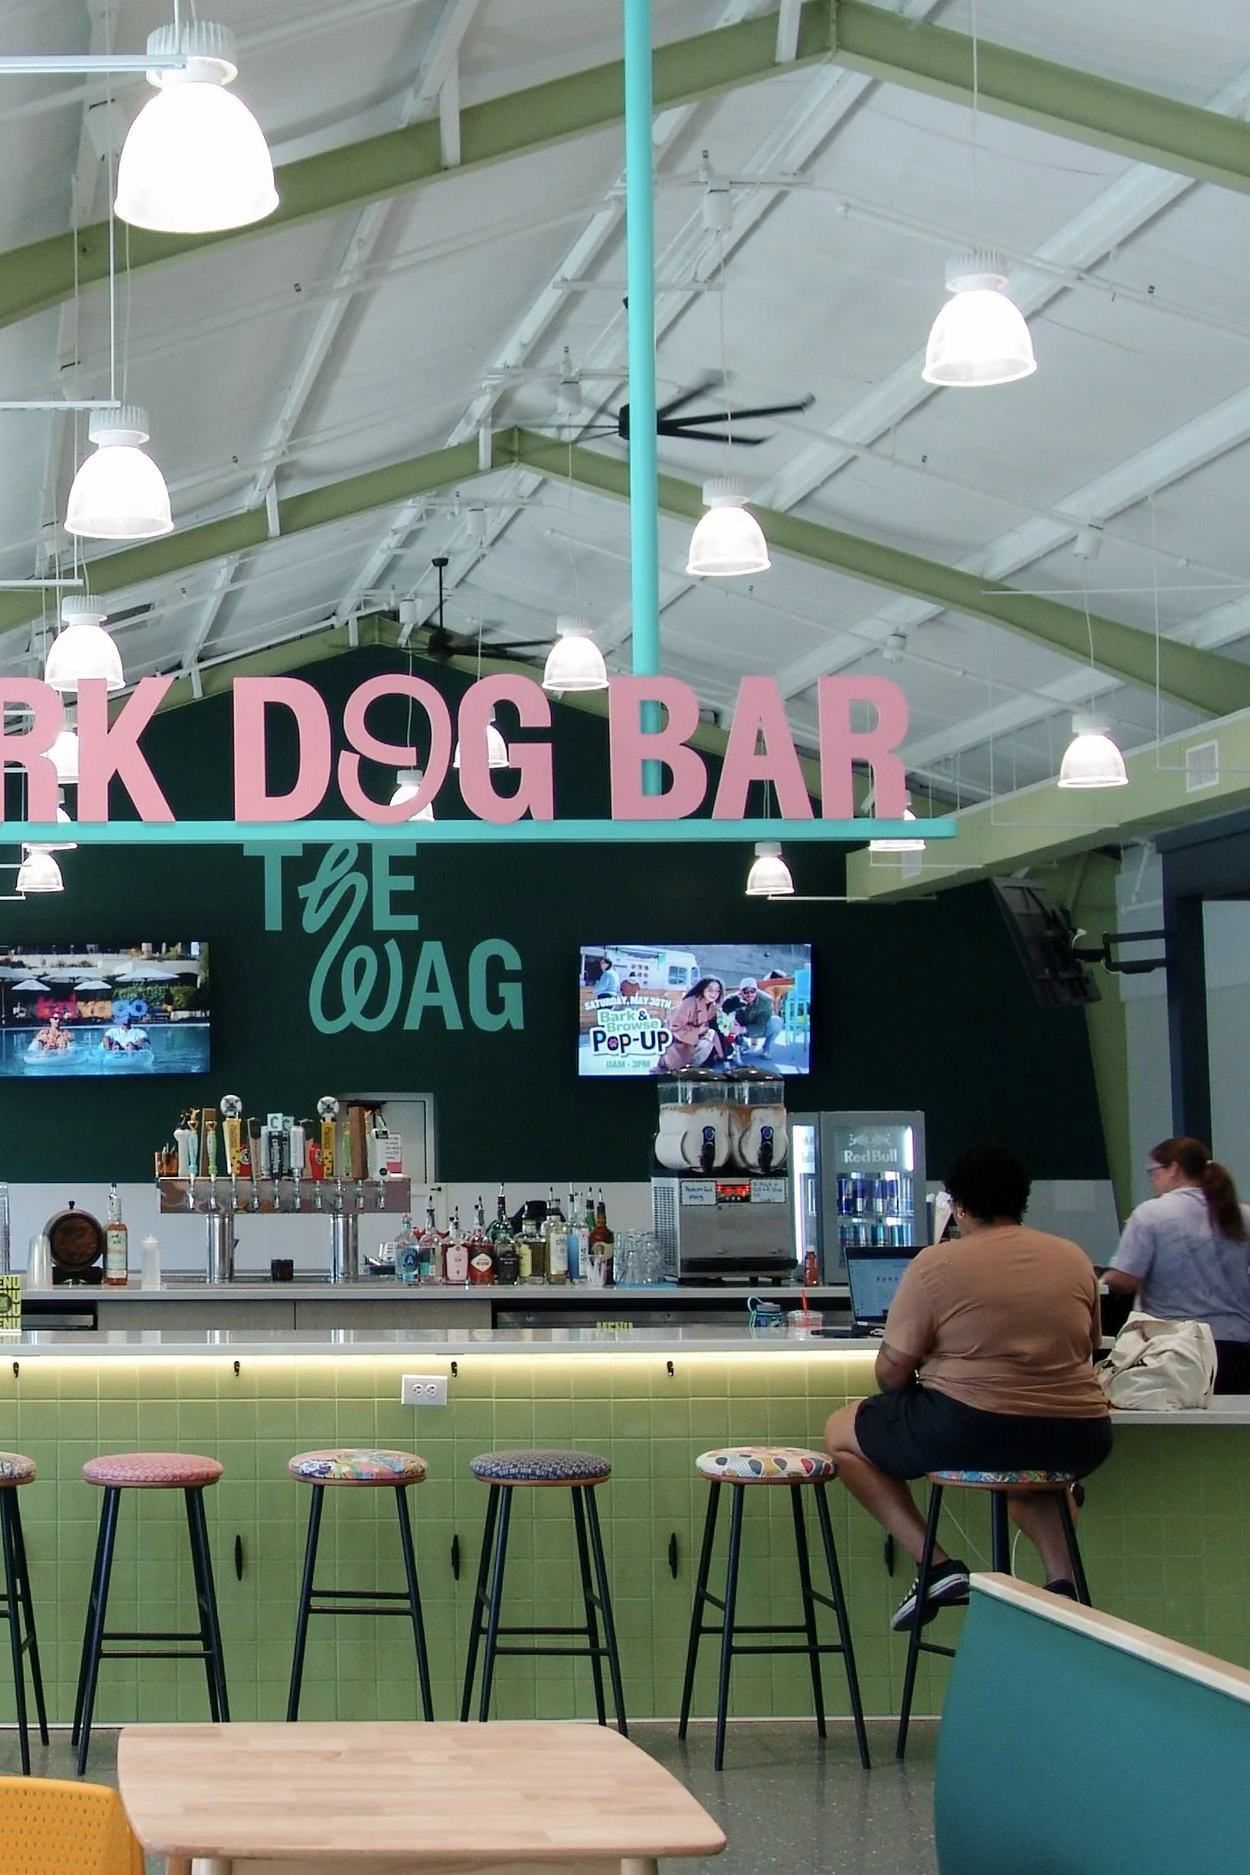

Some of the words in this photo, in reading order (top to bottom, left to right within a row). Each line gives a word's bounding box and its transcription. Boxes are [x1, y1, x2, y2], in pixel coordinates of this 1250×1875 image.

[232, 674, 554, 824] DOG
[608, 675, 915, 822] BAR
[630, 995, 649, 1007] MAY
[600, 1011, 636, 1023] Bark
[638, 1010, 648, 1021] &
[607, 1020, 659, 1033] Browse
[844, 1150, 871, 1164] Red
[871, 1149, 898, 1163] Bull
